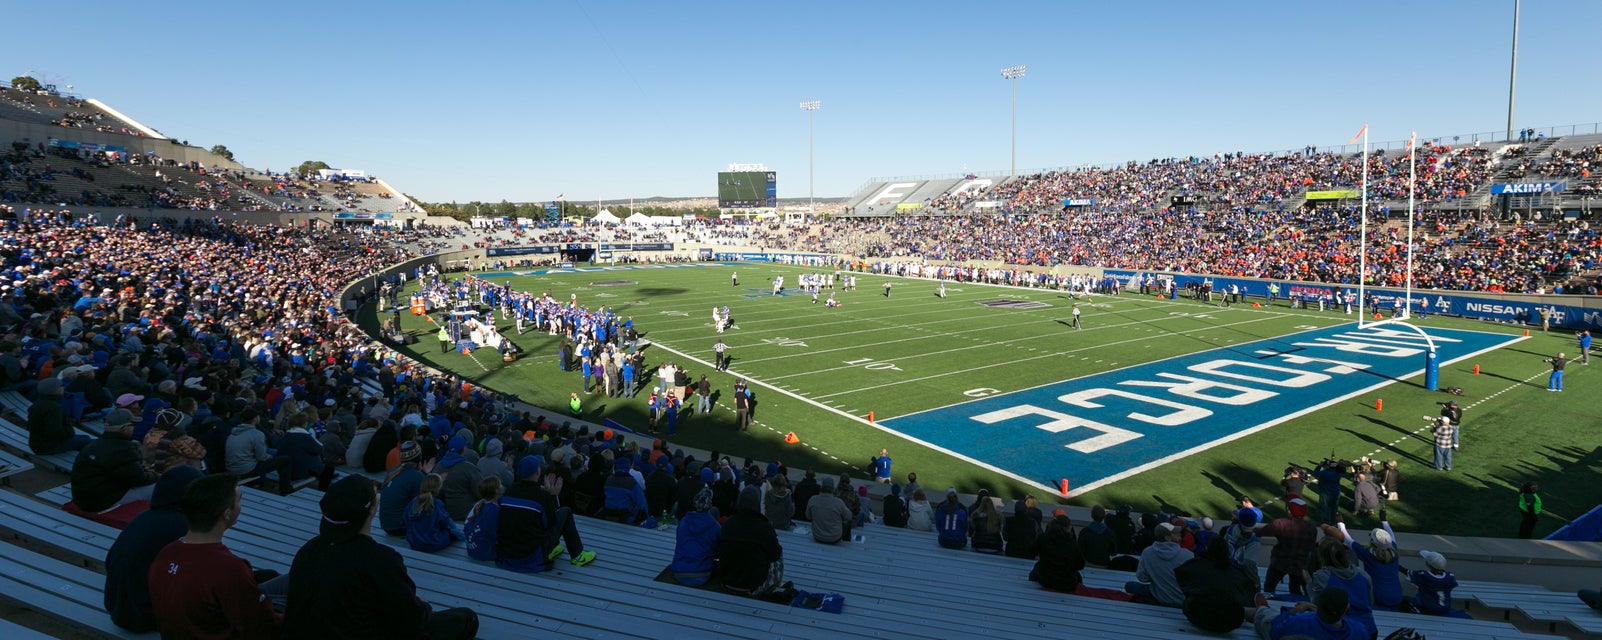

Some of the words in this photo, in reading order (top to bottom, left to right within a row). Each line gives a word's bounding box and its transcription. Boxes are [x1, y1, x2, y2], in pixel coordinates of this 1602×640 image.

[1502, 183, 1552, 193] AKIMA
[1435, 296, 1450, 312] AF
[1466, 302, 1528, 316] NISSAN
[843, 357, 897, 371] 10
[963, 386, 1002, 399] G
[969, 350, 1372, 454] FORCE
[945, 514, 958, 531] 11
[168, 562, 179, 575] 34
